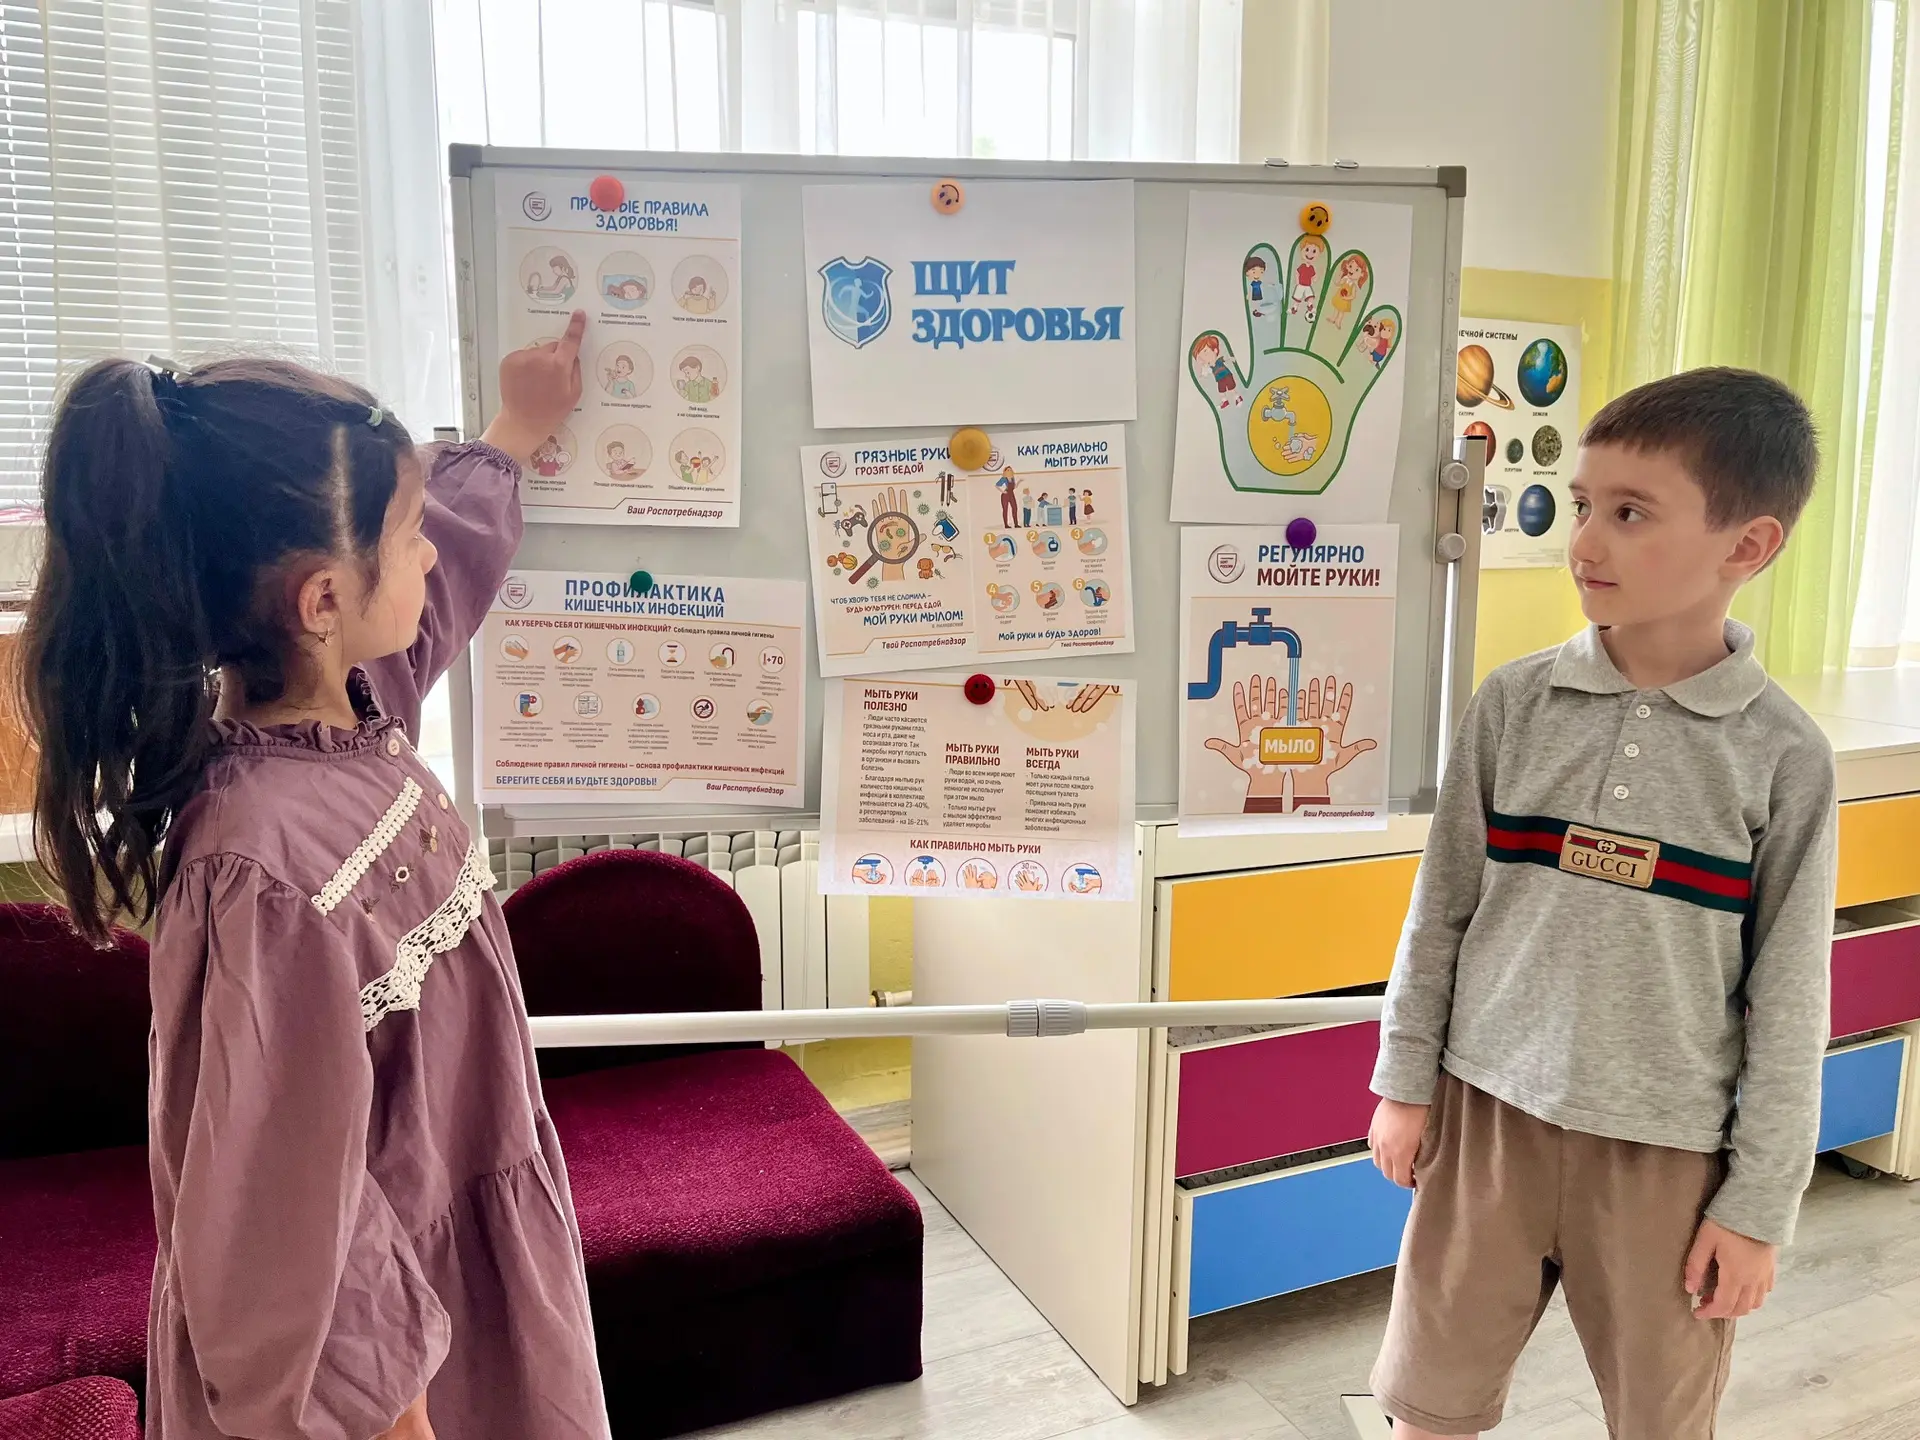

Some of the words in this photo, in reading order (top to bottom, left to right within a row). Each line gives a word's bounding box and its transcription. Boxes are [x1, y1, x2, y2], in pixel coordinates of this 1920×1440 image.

[570, 196, 640, 214] ПРОЫЕ
[644, 200, 709, 217] ПРАВИЛА
[596, 214, 678, 232] ЗДОРОВЬЯ!
[910, 259, 1017, 303] ЩИТ
[911, 306, 1125, 350] ЗДОРОВЬЯ
[1485, 331, 1518, 341] СИСТЕМЫ
[1017, 445, 1039, 457] КАК
[1042, 441, 1108, 455] ПРАВИЛЬНО
[854, 448, 918, 464] ГРЯЗНЫЕ
[1044, 456, 1077, 468] МЫТЬ
[1080, 455, 1109, 466] РУКИ
[855, 465, 890, 476] ГРОЗЯТ
[892, 462, 924, 475] БЕДОЙ
[627, 505, 646, 515] Ваш
[646, 506, 723, 519] Роспотребнадзор
[987, 534, 993, 544] 1
[1029, 531, 1036, 541] 2
[1074, 528, 1081, 539] 3
[1258, 545, 1365, 563] РЕГУЛЯРНО
[1257, 564, 1321, 586] МОЙТЕ
[1325, 568, 1381, 586] РУКИ!
[988, 585, 996, 594] 4
[1033, 581, 1040, 591] 5
[1076, 579, 1083, 589] 6
[848, 596, 869, 604] ХВОРЬ
[896, 593, 927, 601] СЛОМИЛА
[902, 602, 923, 610] ПЕРЕД
[924, 600, 942, 609] ЕДОЙ
[565, 598, 645, 613] КИШЕЧНЫХ
[648, 602, 724, 619] ИНФЕКЦИЙ
[863, 612, 887, 626] МОЙ
[889, 613, 918, 624] РУКИ
[920, 610, 964, 623] МЫЛОМ!
[521, 620, 553, 628] УБЕРЕЧЬ
[584, 622, 626, 631] КИШЕЧНЫХ
[627, 623, 672, 632] ИНФЕКЦИЙ?
[673, 626, 706, 635] Соблюдать
[707, 629, 730, 637] правила
[998, 631, 1015, 641] Мой
[1016, 632, 1036, 641] руки
[1045, 629, 1066, 639] будь
[1068, 627, 1101, 638] здоров!
[882, 641, 899, 649] Твой
[900, 637, 967, 648] Роспотребнадзор
[864, 689, 892, 699] МЫТЬ
[893, 690, 918, 700] РУКИ
[863, 700, 908, 712] ПОЛЕЗНО
[945, 743, 973, 753] МЫТЬ
[975, 744, 1000, 755] РУКИ
[1025, 747, 1054, 758] МЫТЬ
[1055, 749, 1079, 759] РУКИ
[1264, 738, 1315, 755] МЫЛО
[945, 754, 1001, 767] ПРАВИЛЬНО
[1025, 759, 1061, 771] ВСЕГДА
[495, 760, 543, 769] Соблюдение
[543, 762, 570, 770] правил
[571, 761, 597, 769] личной
[662, 762, 713, 771] профилактики
[713, 765, 750, 773] кишечных
[750, 766, 785, 775] инфекций
[496, 775, 540, 785] БЕРЕГИТЕ
[542, 776, 564, 785] СЕБЯ
[566, 777, 574, 785] И
[575, 776, 609, 787] БУДЬТЕ
[611, 777, 657, 787] ЗДОРОВЫ!
[722, 783, 784, 795] Роспотребнадзор
[910, 839, 930, 850] КАК
[930, 840, 986, 852] ПРАВИЛЬНО
[987, 841, 1015, 853] МЫТЬ
[1016, 843, 1041, 854] РУКИ
[1571, 850, 1638, 879] GUCCI
